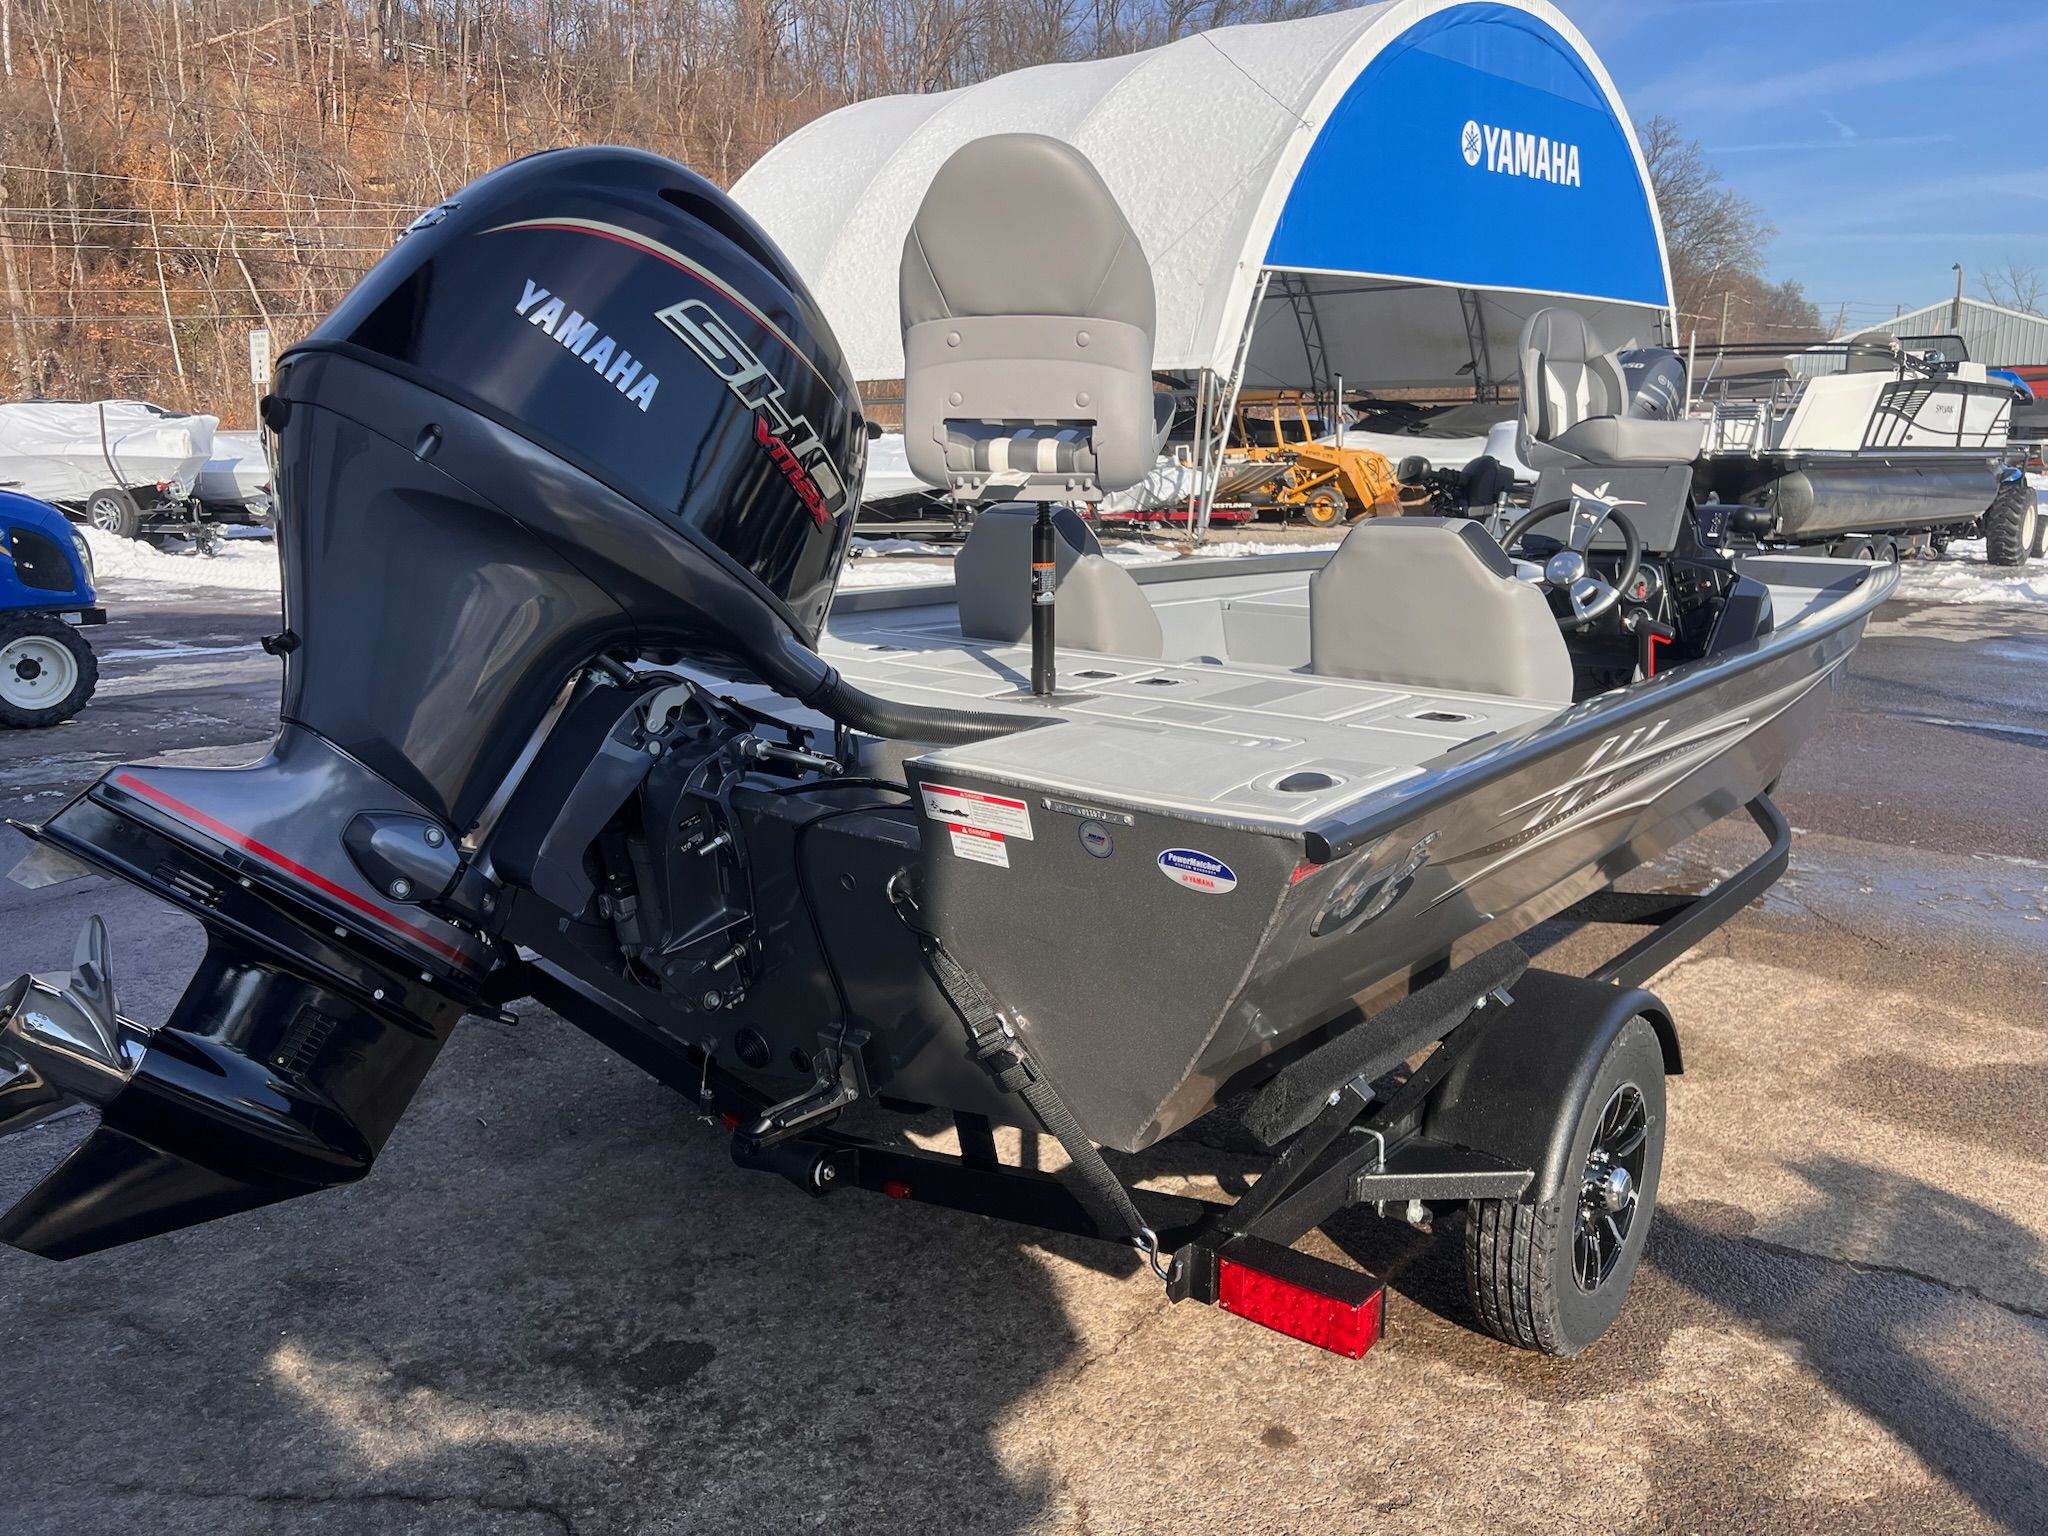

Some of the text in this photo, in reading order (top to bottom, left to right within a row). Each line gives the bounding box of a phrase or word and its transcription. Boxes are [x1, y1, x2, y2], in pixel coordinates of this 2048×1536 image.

[1482, 124, 1581, 188] YAMAHA
[513, 278, 661, 413] YAMAHA
[967, 827, 992, 838] DANGER
[1168, 853, 1222, 872] PowerMatched
[1188, 875, 1215, 888] YAMAHA
